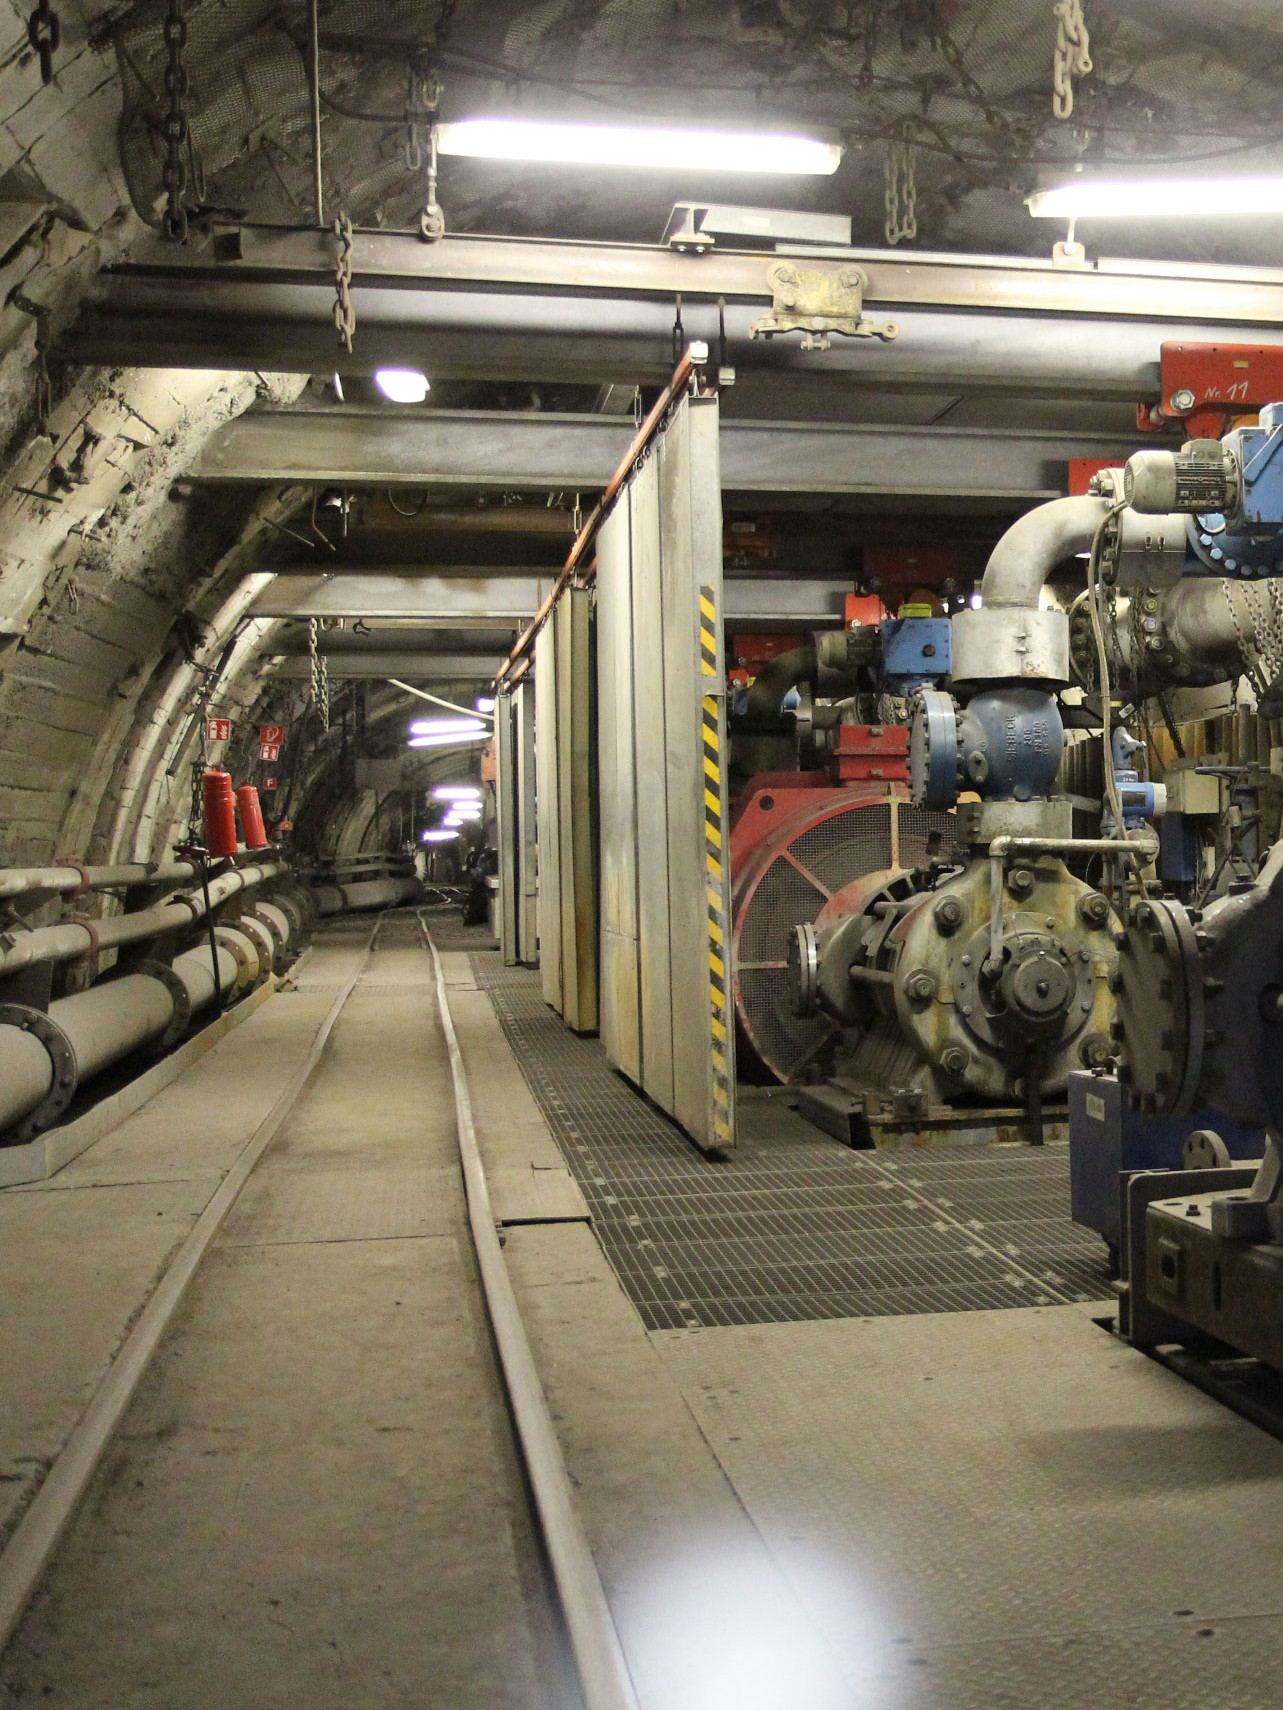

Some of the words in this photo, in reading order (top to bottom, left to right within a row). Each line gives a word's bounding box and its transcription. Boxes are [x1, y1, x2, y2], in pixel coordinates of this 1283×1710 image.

[1204, 386, 1222, 399] Nr.
[1226, 380, 1249, 400] 11
[267, 778, 273, 787] F
